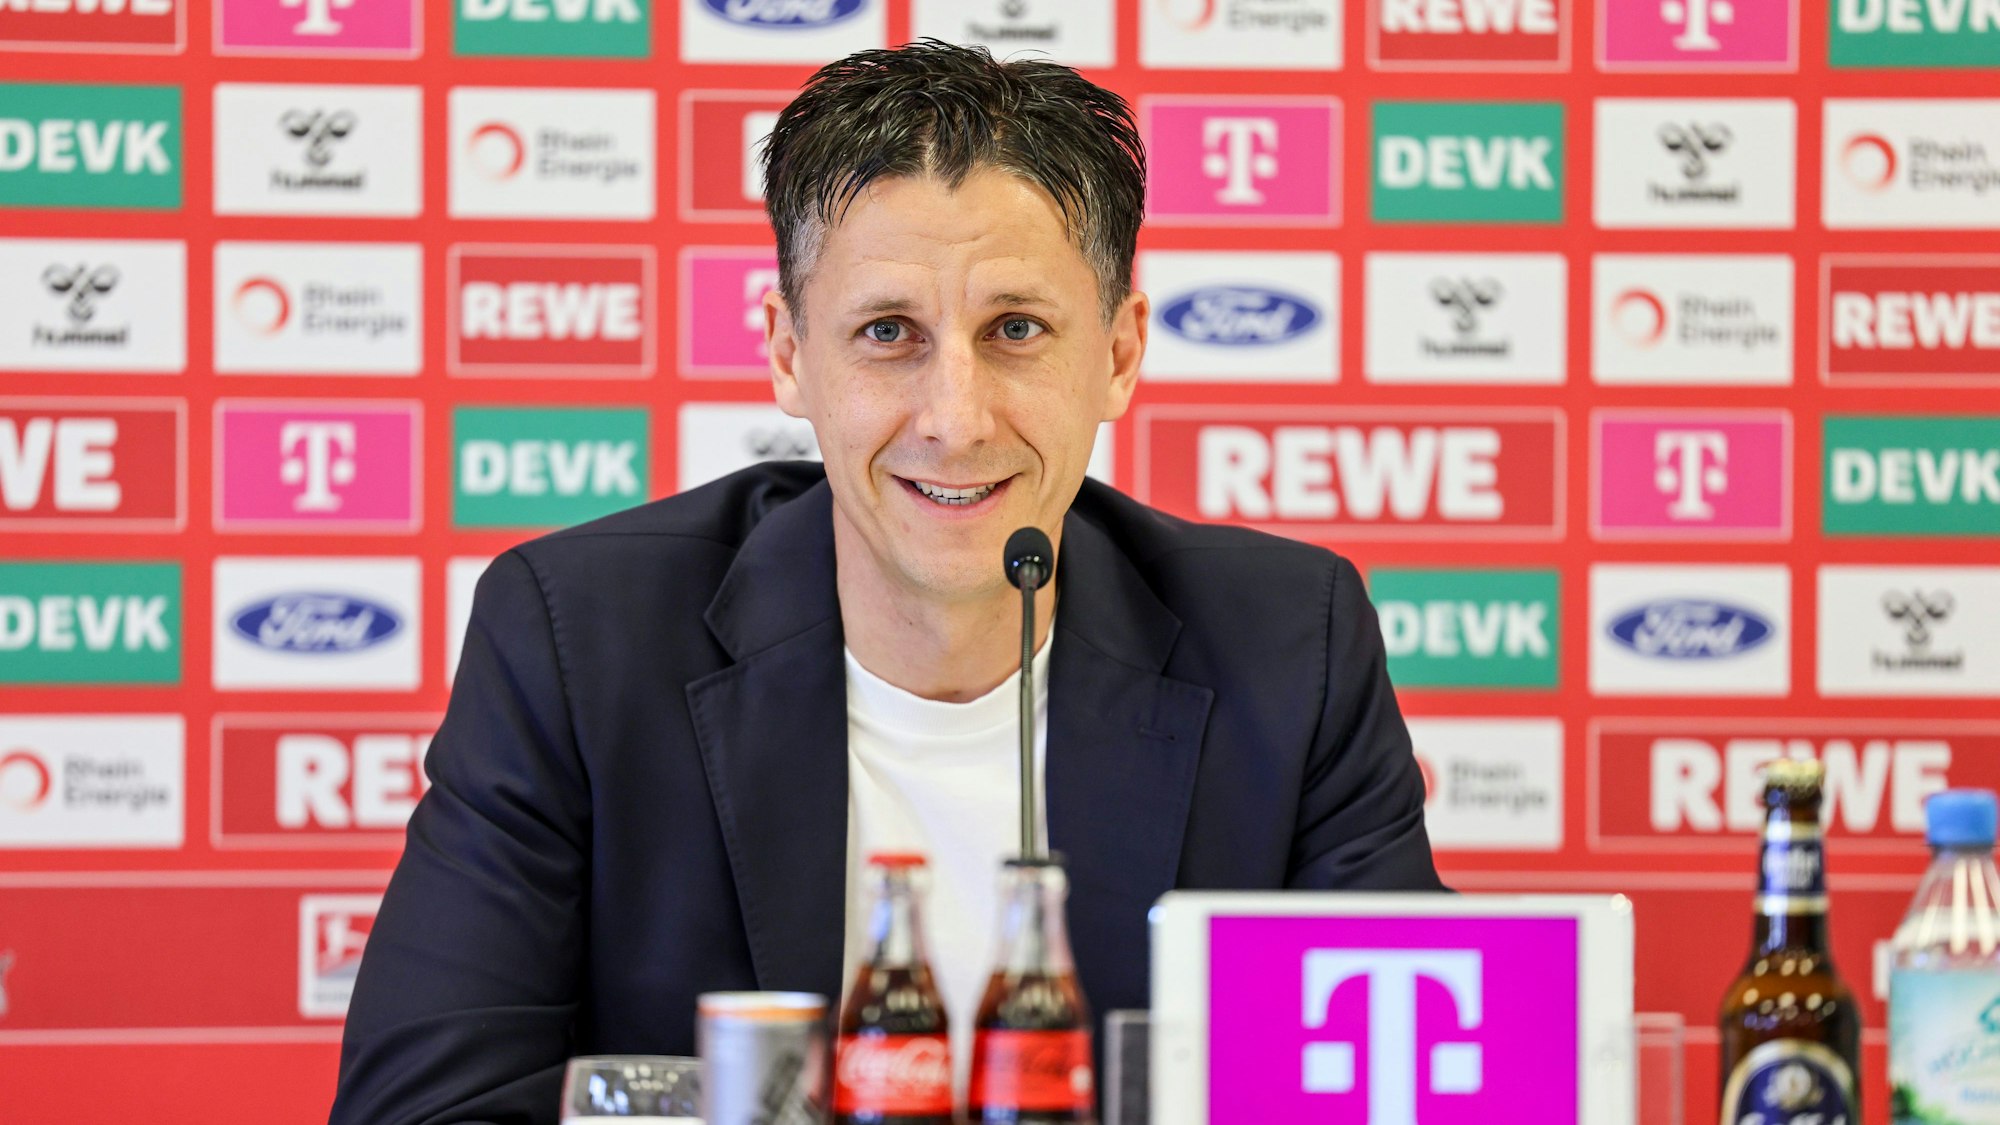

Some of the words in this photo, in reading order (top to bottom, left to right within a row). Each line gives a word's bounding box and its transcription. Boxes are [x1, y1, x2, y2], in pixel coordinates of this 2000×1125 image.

[0, 118, 170, 174] DEVK
[536, 129, 611, 152] Rhein
[1203, 117, 1277, 205] T
[1908, 140, 1986, 164] Rhein
[272, 173, 364, 191] hummel
[537, 154, 639, 183] Energie
[1378, 135, 1553, 189] DEVK
[1650, 184, 1741, 204] hummel
[302, 283, 379, 306] Rhein
[462, 283, 643, 340] REWE
[1181, 289, 1295, 341] Ford
[1678, 295, 1754, 318] Rhein
[33, 325, 127, 346] hummel
[302, 307, 407, 339] Energie
[1678, 319, 1780, 349] Energie
[1833, 292, 2000, 348] REWE
[1423, 338, 1510, 358] hummel
[281, 422, 355, 511] T
[461, 440, 638, 495] DEVK
[1198, 426, 1503, 519] REWE
[1655, 431, 1728, 519] T
[1833, 448, 2000, 503] DEVK
[0, 596, 169, 650] DEVK
[258, 594, 374, 648] Ford
[1380, 601, 1548, 657] DEVK
[1634, 602, 1746, 655] Ford
[1873, 652, 1964, 672] hummel
[63, 756, 143, 779] Rhein
[1447, 760, 1523, 781] Rhein
[63, 780, 169, 812] Energie
[1447, 783, 1548, 814] Energie
[1302, 948, 1483, 1125] T
